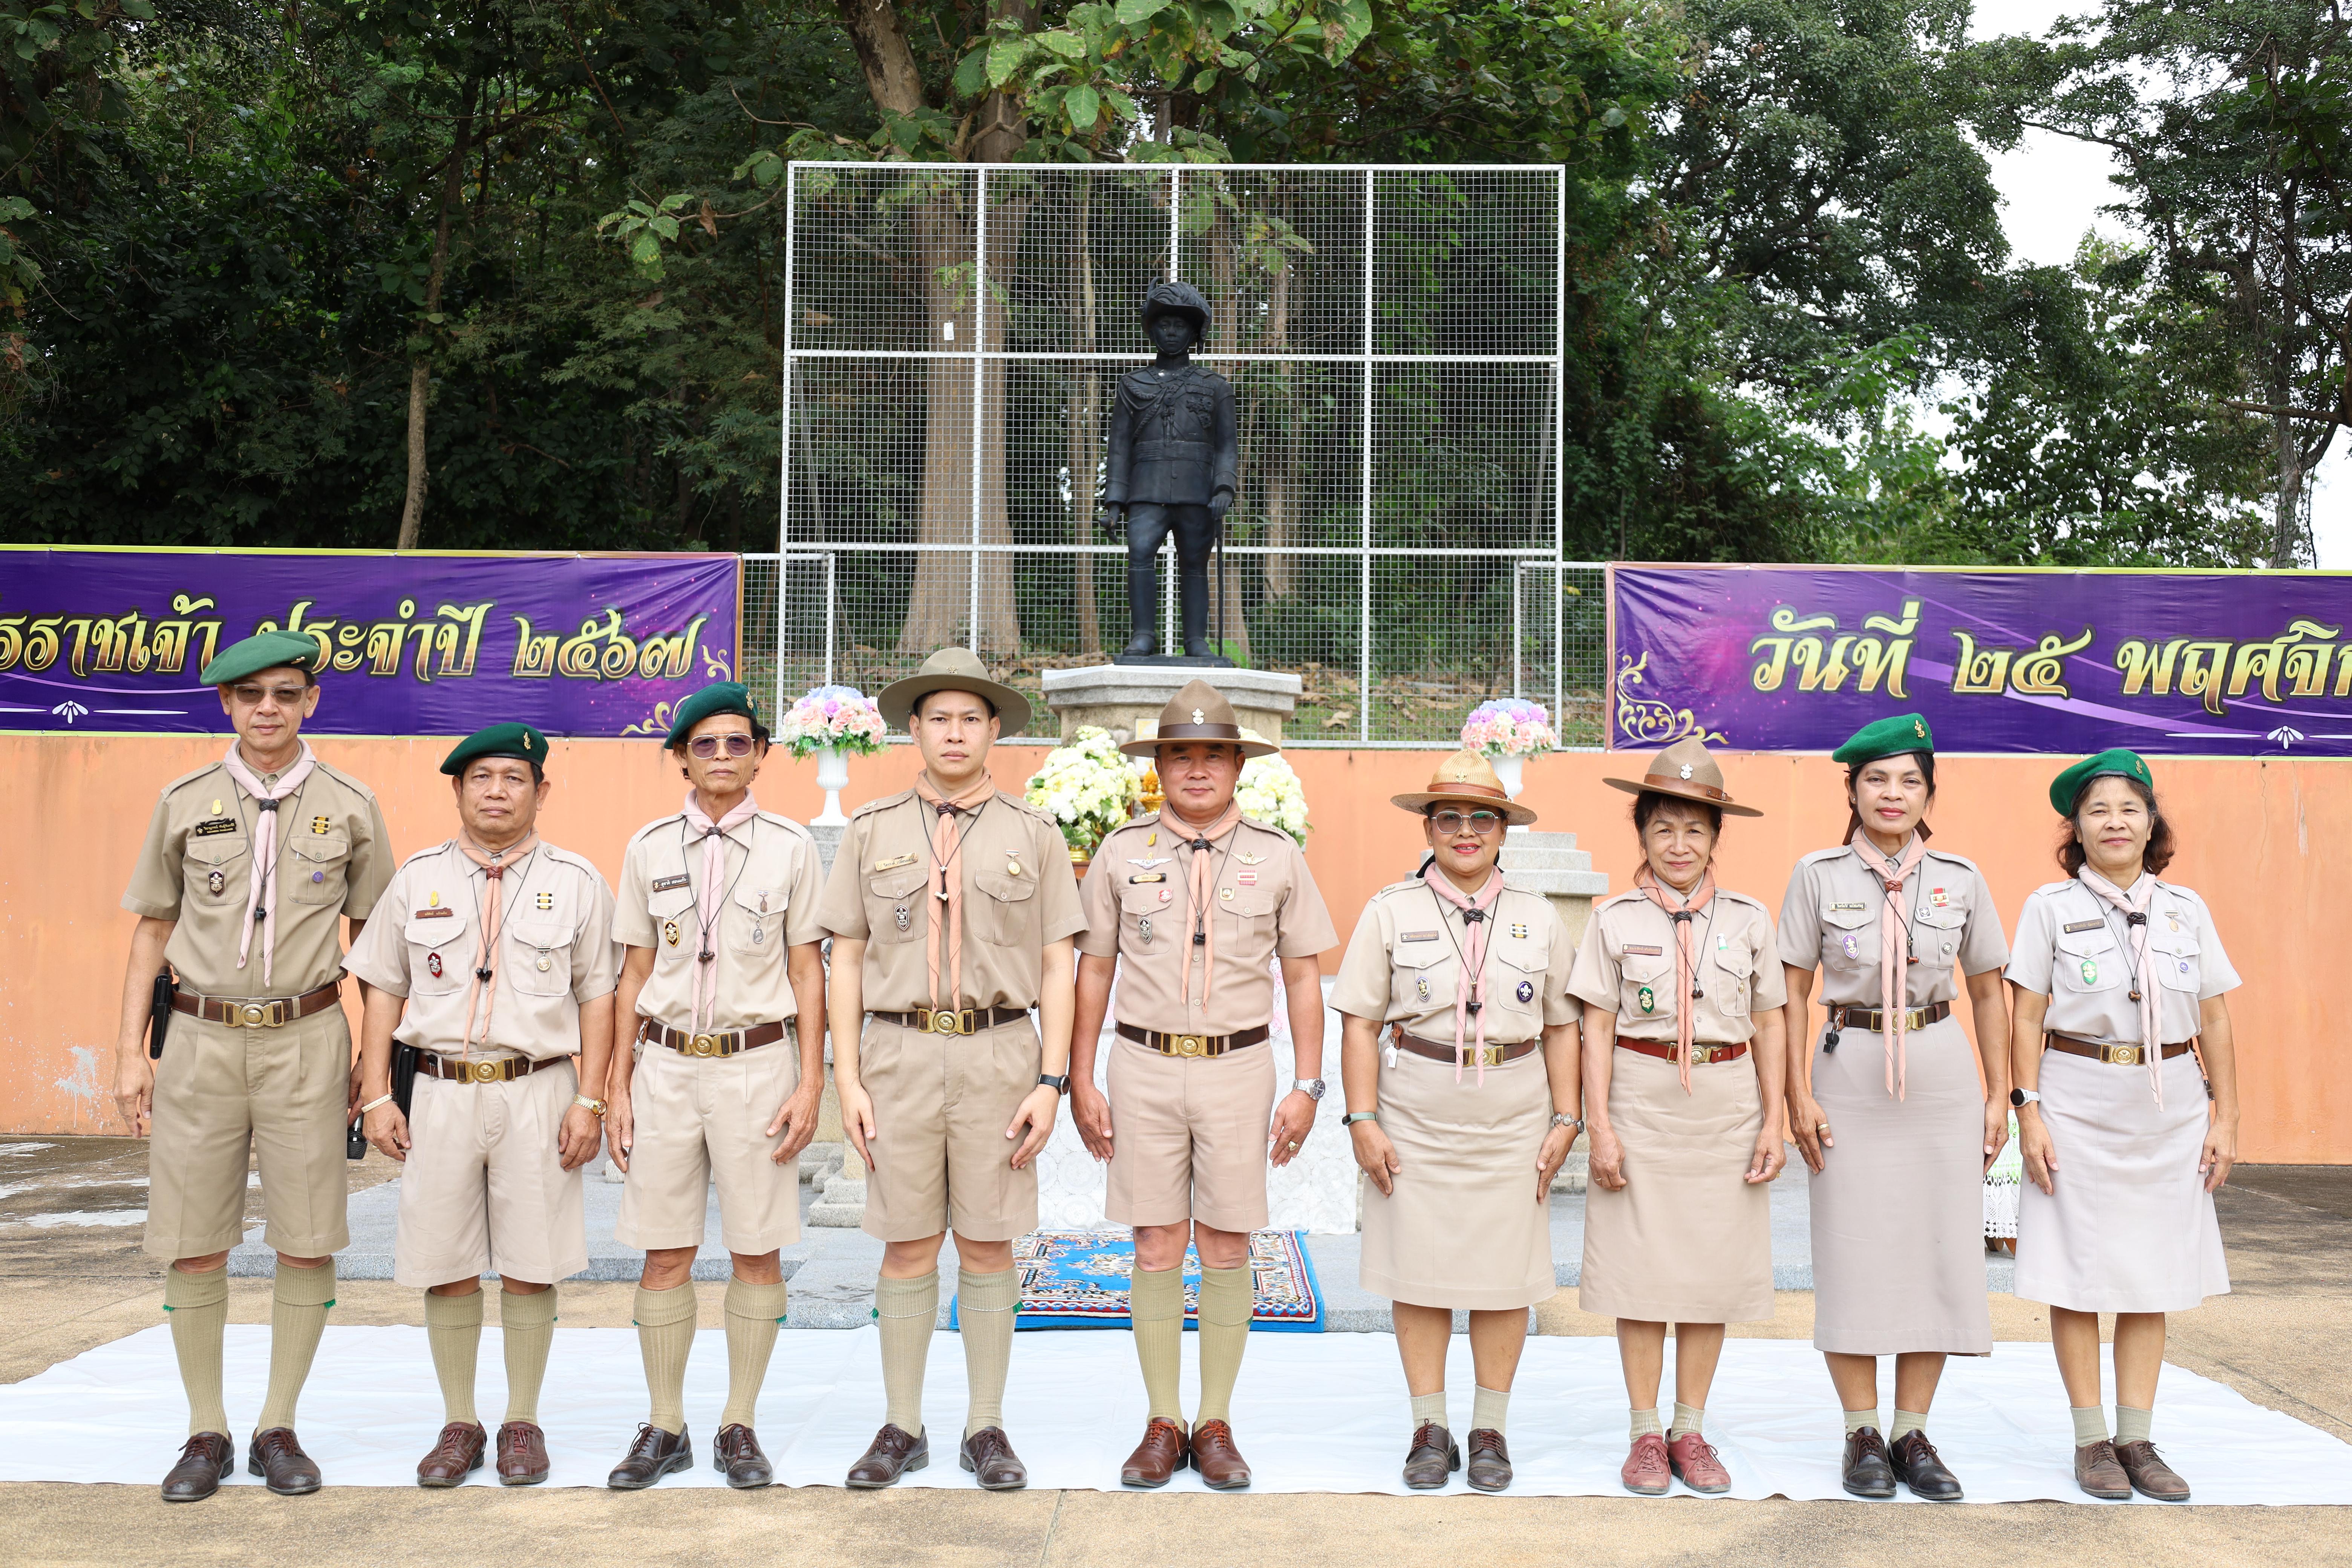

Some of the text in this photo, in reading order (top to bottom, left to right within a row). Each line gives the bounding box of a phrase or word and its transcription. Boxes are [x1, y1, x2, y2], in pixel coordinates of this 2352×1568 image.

[513, 609, 707, 680] ๒๕๖๗
[1752, 601, 1919, 698] วันที่
[1953, 629, 2092, 697] ๒๕
